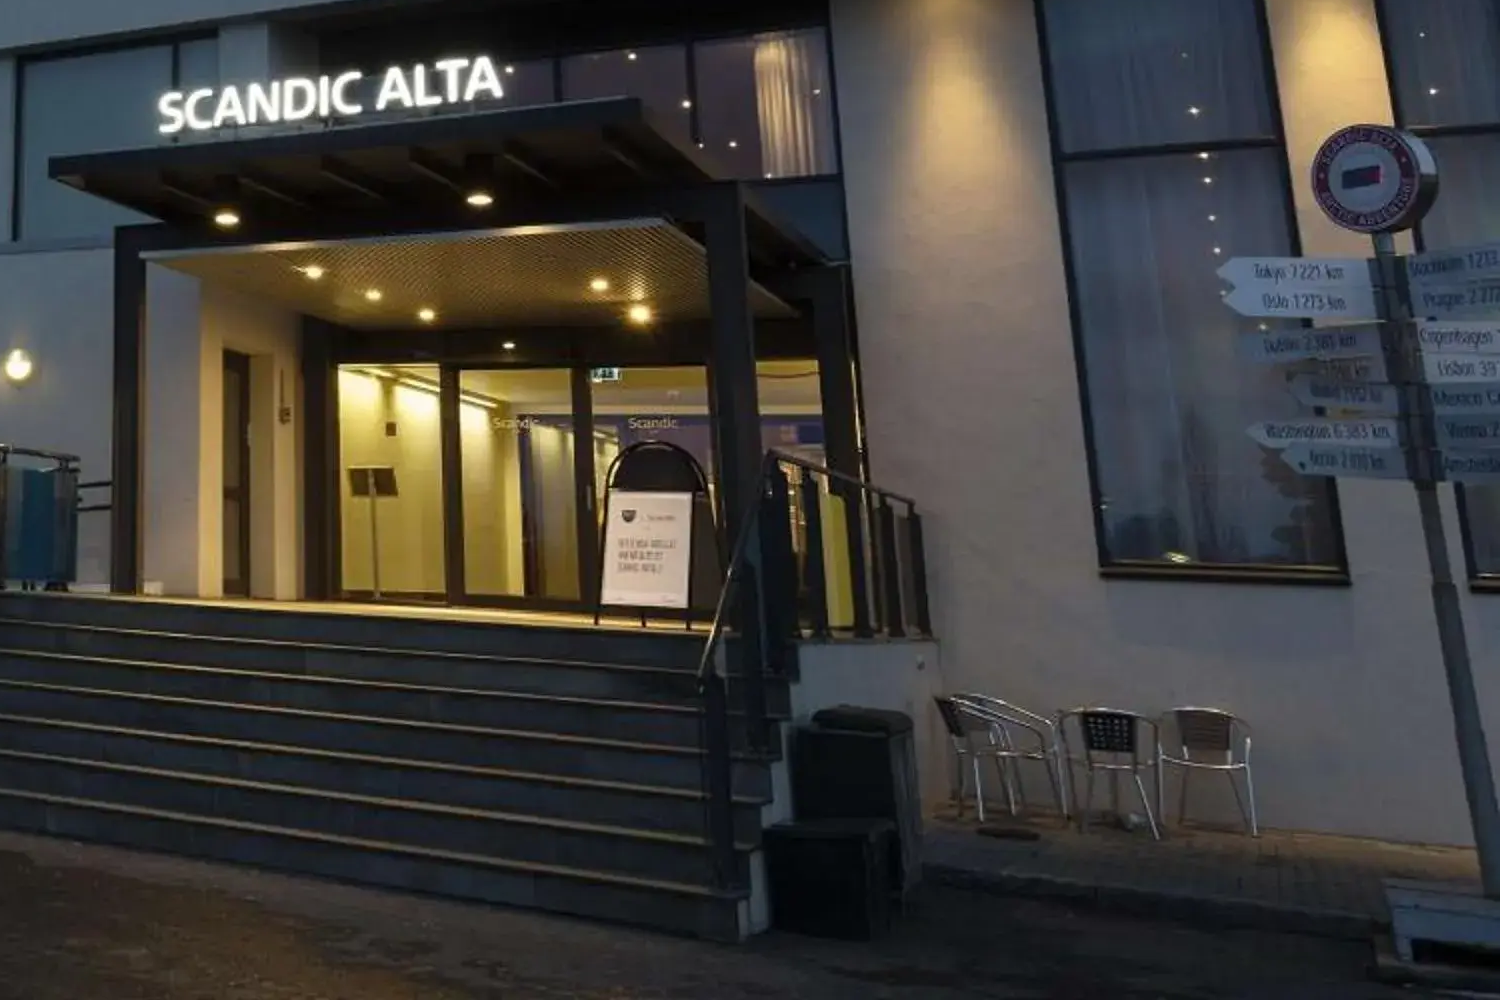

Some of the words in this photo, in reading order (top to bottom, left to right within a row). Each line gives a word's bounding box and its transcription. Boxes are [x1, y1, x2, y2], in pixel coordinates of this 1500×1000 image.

[158, 70, 363, 133] SCANDIC
[375, 56, 504, 111] ALTA
[1254, 263, 1287, 285] Tokyo
[1262, 293, 1289, 308] Oslo
[1420, 327, 1493, 349] Copenhagen
[1437, 360, 1476, 377] Lisbon
[627, 415, 678, 429] Scandic
